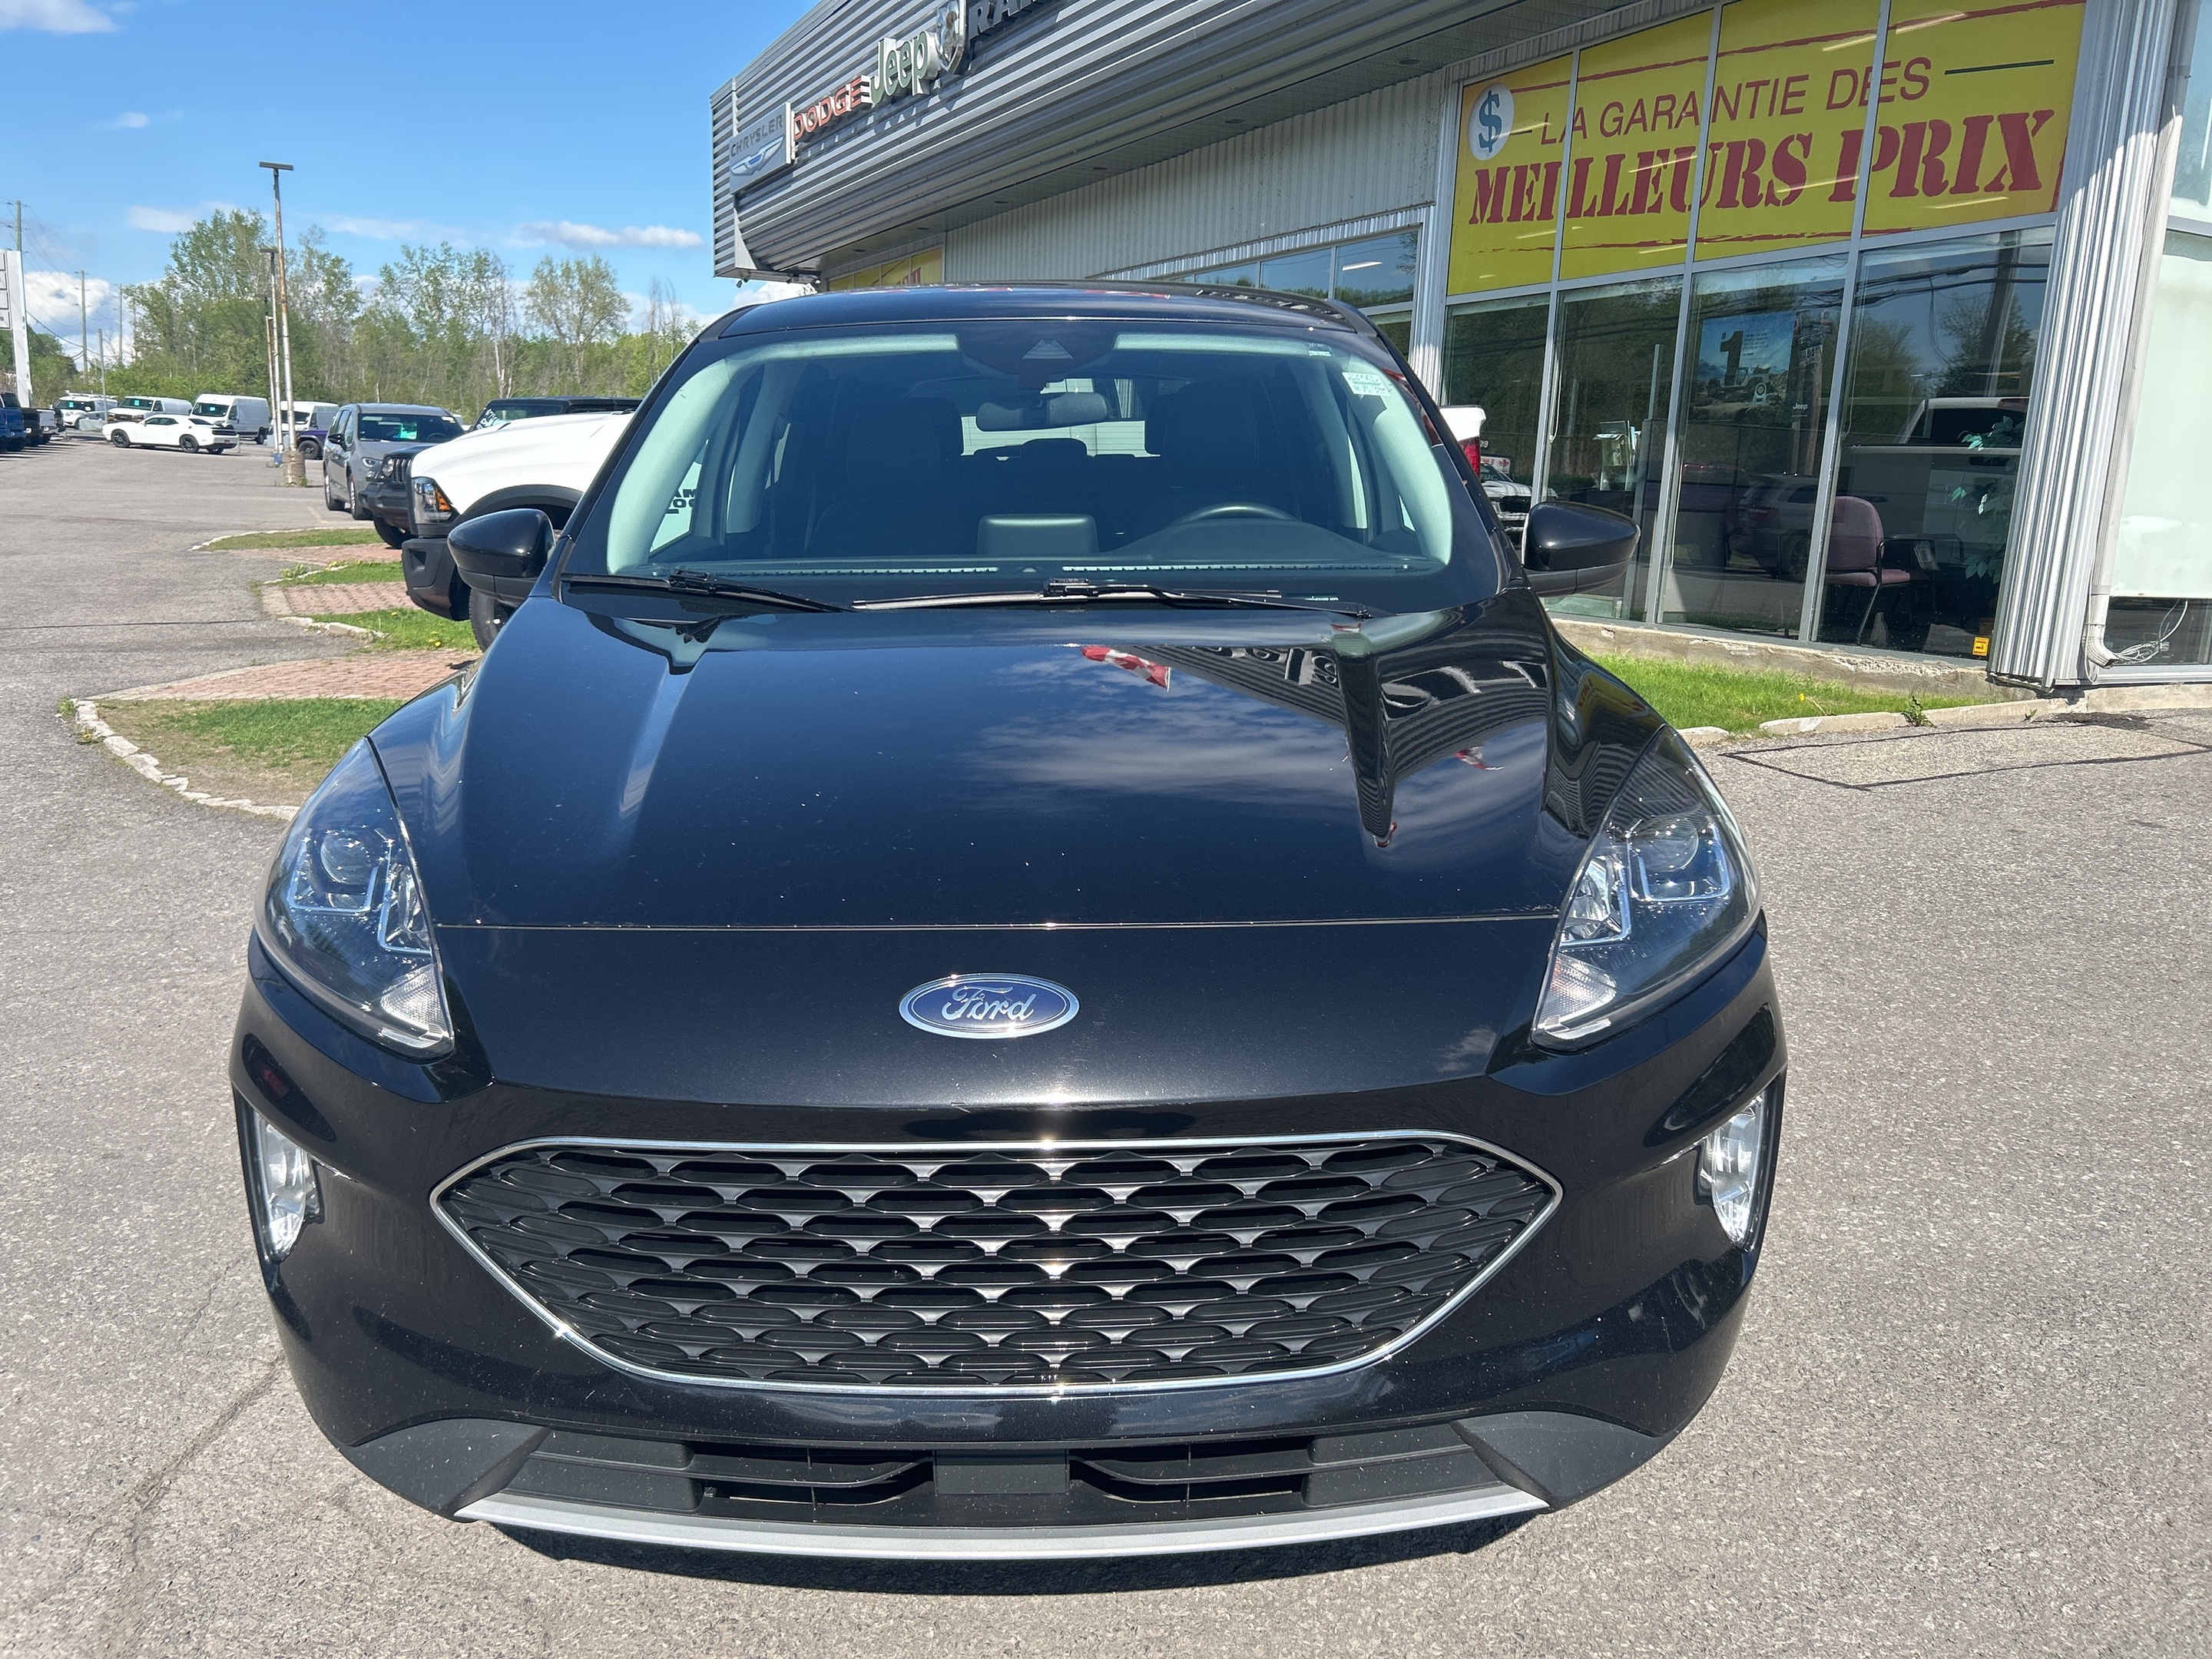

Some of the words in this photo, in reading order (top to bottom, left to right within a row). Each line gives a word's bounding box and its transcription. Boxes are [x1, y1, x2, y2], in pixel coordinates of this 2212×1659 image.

[871, 31, 928, 104] Jeep
[793, 77, 862, 141] DODGE
[1541, 107, 1587, 145] LA
[1600, 74, 1810, 138] GARANTIE
[1826, 57, 1932, 110] DES
[730, 114, 783, 157] CHRYSLER
[1469, 132, 1813, 224] MEILLEURS
[1828, 109, 2055, 202] PRIX
[1793, 402, 1808, 411] Jeep
[942, 986, 1036, 1021] Ford
